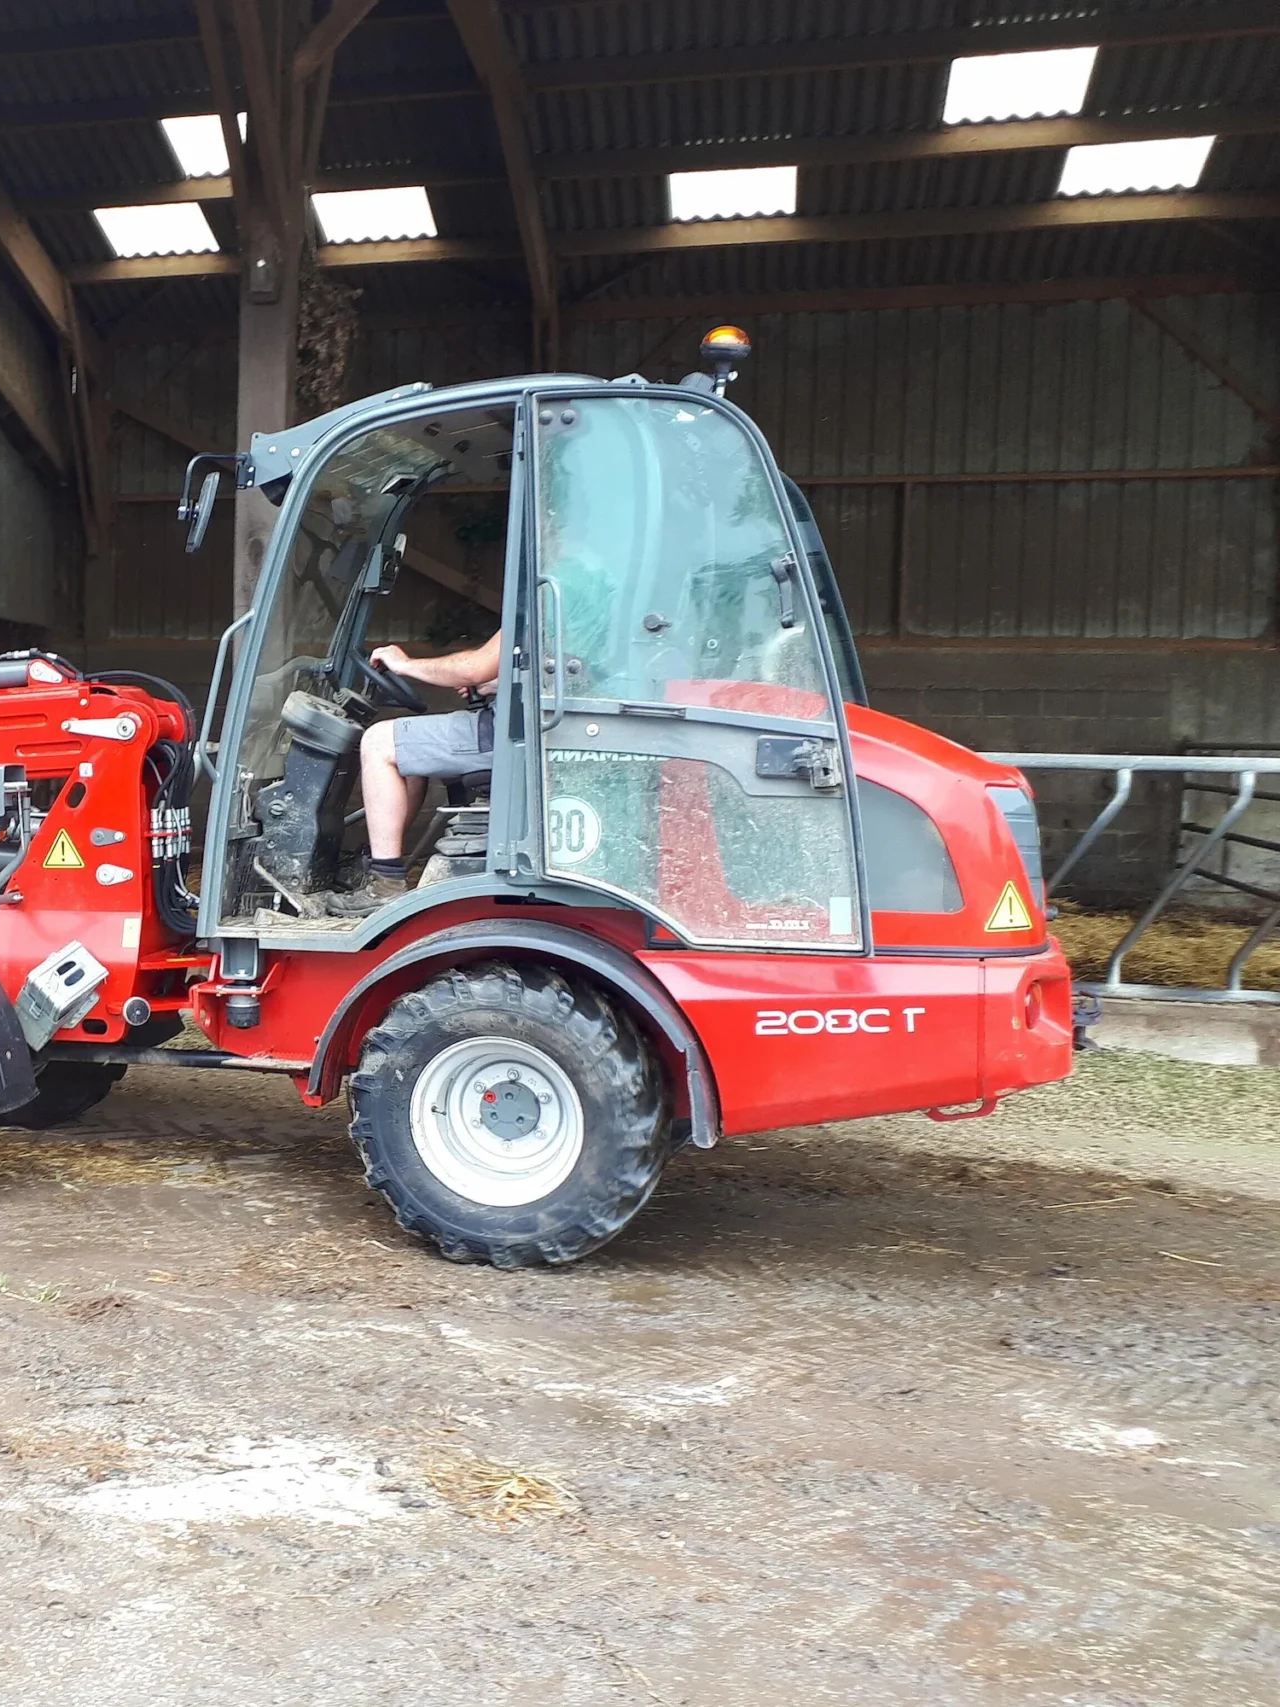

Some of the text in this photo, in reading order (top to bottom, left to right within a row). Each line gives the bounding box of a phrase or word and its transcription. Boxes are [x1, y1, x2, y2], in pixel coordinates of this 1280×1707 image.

[549, 809, 584, 852] 30
[755, 1007, 926, 1035] 208C T
